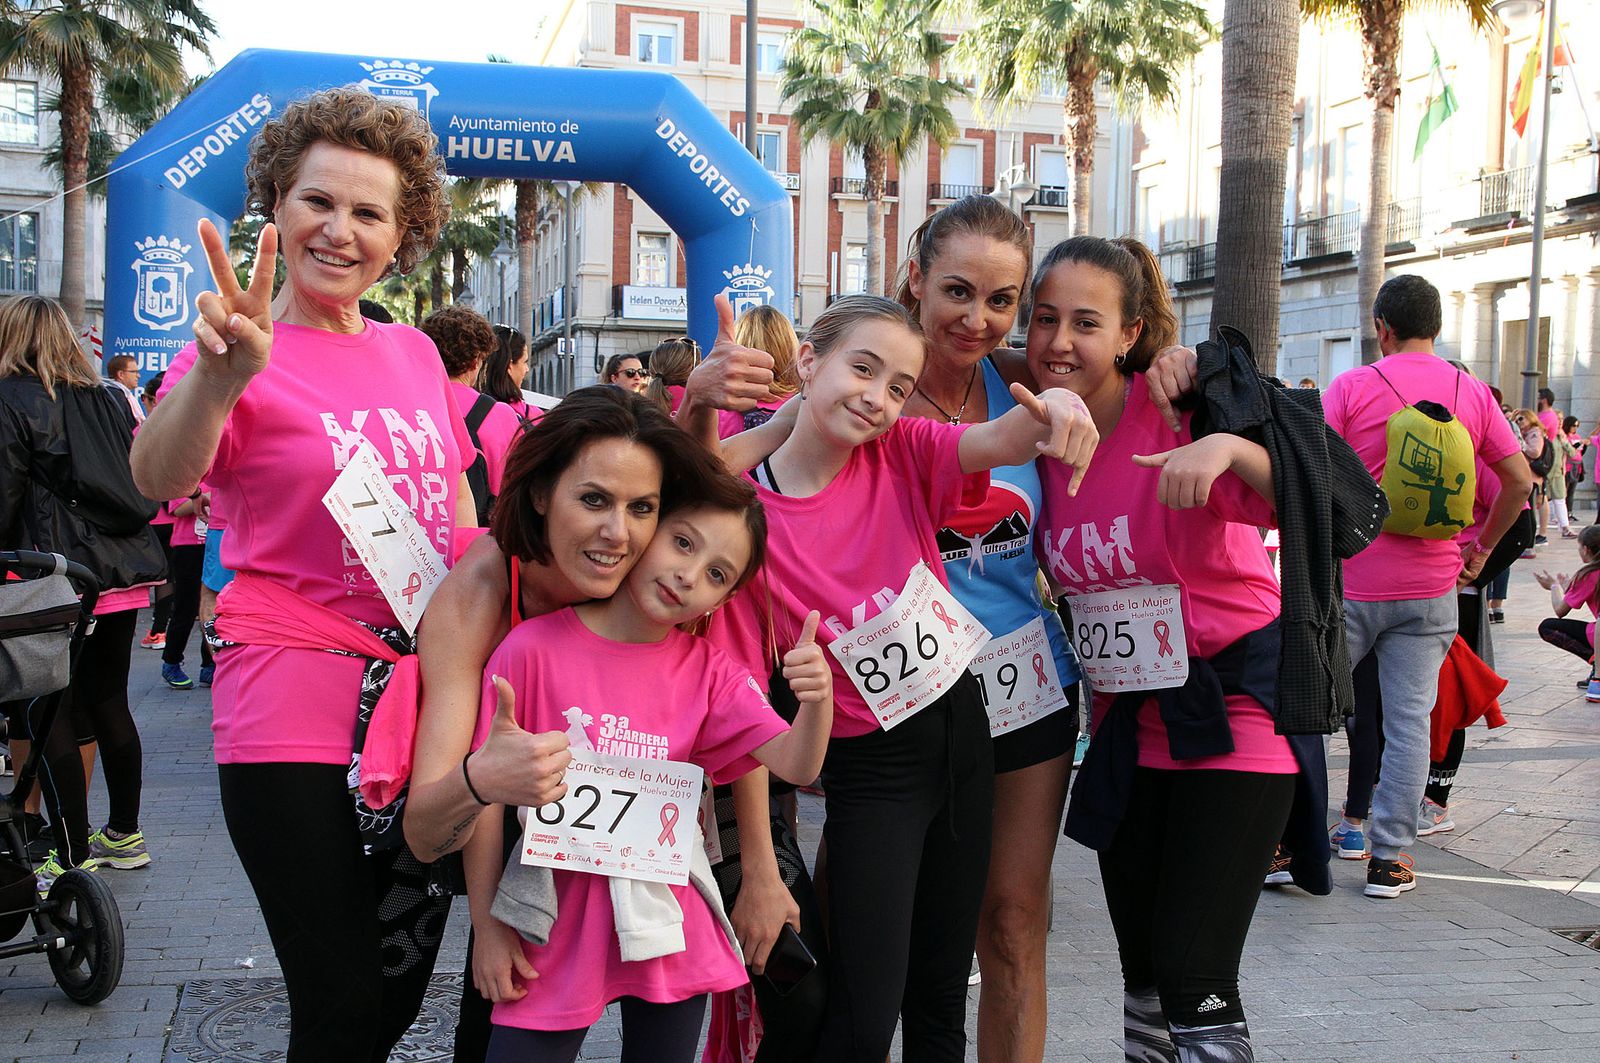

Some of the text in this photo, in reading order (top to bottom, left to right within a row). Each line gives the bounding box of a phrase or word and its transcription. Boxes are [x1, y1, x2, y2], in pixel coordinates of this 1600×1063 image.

[449, 115, 579, 134] Ayuntamiento de
[164, 93, 272, 190] DEPORTES
[447, 136, 577, 163] HUELVA
[655, 119, 751, 217] DEPORTES
[630, 295, 678, 306] Helen Doron
[319, 408, 446, 471] KM
[371, 472, 399, 518] Carrera
[408, 532, 418, 547] la
[416, 546, 440, 579] Mujer
[985, 543, 1009, 554] Ultra
[1010, 536, 1027, 549] Trail
[1000, 548, 1025, 561] HUELVA
[1044, 515, 1136, 583] KM
[857, 619, 900, 647] Carrera
[901, 608, 912, 621] de
[909, 599, 918, 609] la
[914, 575, 930, 599] Mujer
[1083, 603, 1110, 614] Carrera
[1112, 602, 1125, 612] de
[1128, 599, 1138, 610] la
[1142, 596, 1173, 608] Mujer
[1131, 608, 1174, 620] Huelva 2019
[997, 646, 1010, 657] de
[1011, 641, 1020, 651] la
[1022, 629, 1042, 646] Mujer
[1015, 638, 1044, 659] Huelva 2019
[1078, 620, 1136, 660] 825
[856, 622, 939, 694] 826
[598, 737, 610, 746] DE
[615, 729, 669, 747] CARRERA
[610, 740, 669, 761] MUJER
[567, 757, 695, 789] Carrera de la Mujer
[640, 785, 692, 800] Huelva 2019
[535, 784, 639, 834] 827
[533, 850, 553, 858] Audika
[1197, 1000, 1228, 1013] adidas
